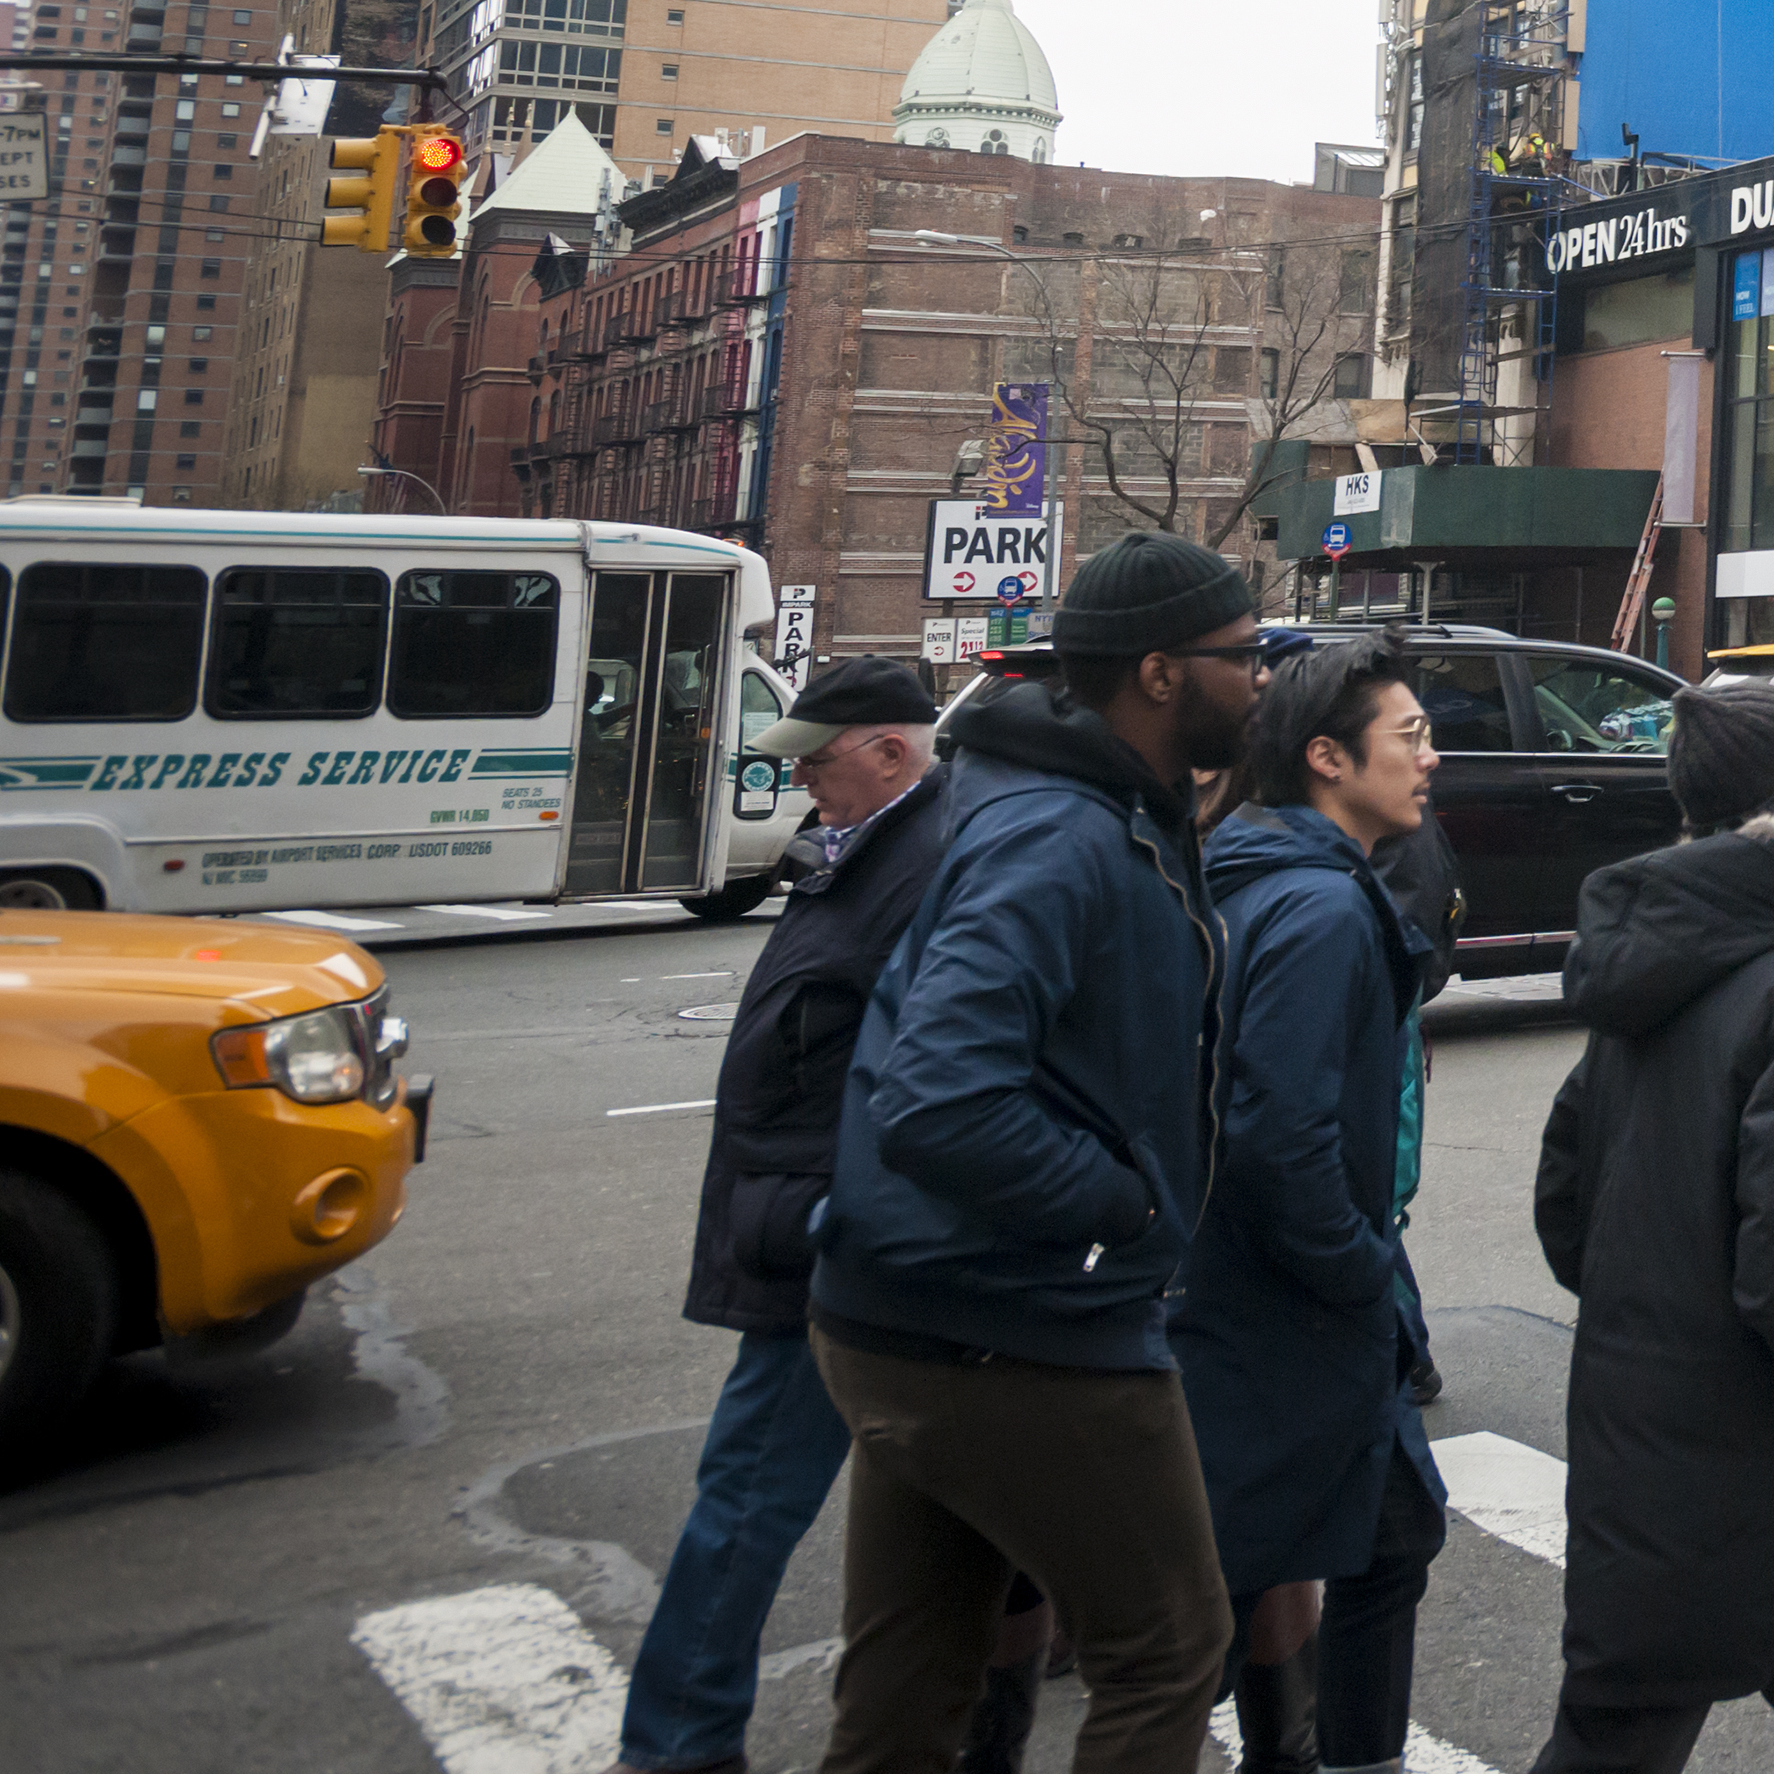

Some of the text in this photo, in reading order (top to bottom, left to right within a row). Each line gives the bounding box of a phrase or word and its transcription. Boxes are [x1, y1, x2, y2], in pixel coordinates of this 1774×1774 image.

[1546, 217, 1617, 274] OPEN
[1346, 475, 1370, 496] HKS
[943, 526, 1048, 564] PARK
[926, 632, 952, 642] ENTER
[89, 749, 472, 791] EXPRESS SERVICE
[502, 787, 529, 798] SEATS
[367, 844, 400, 860] CORP
